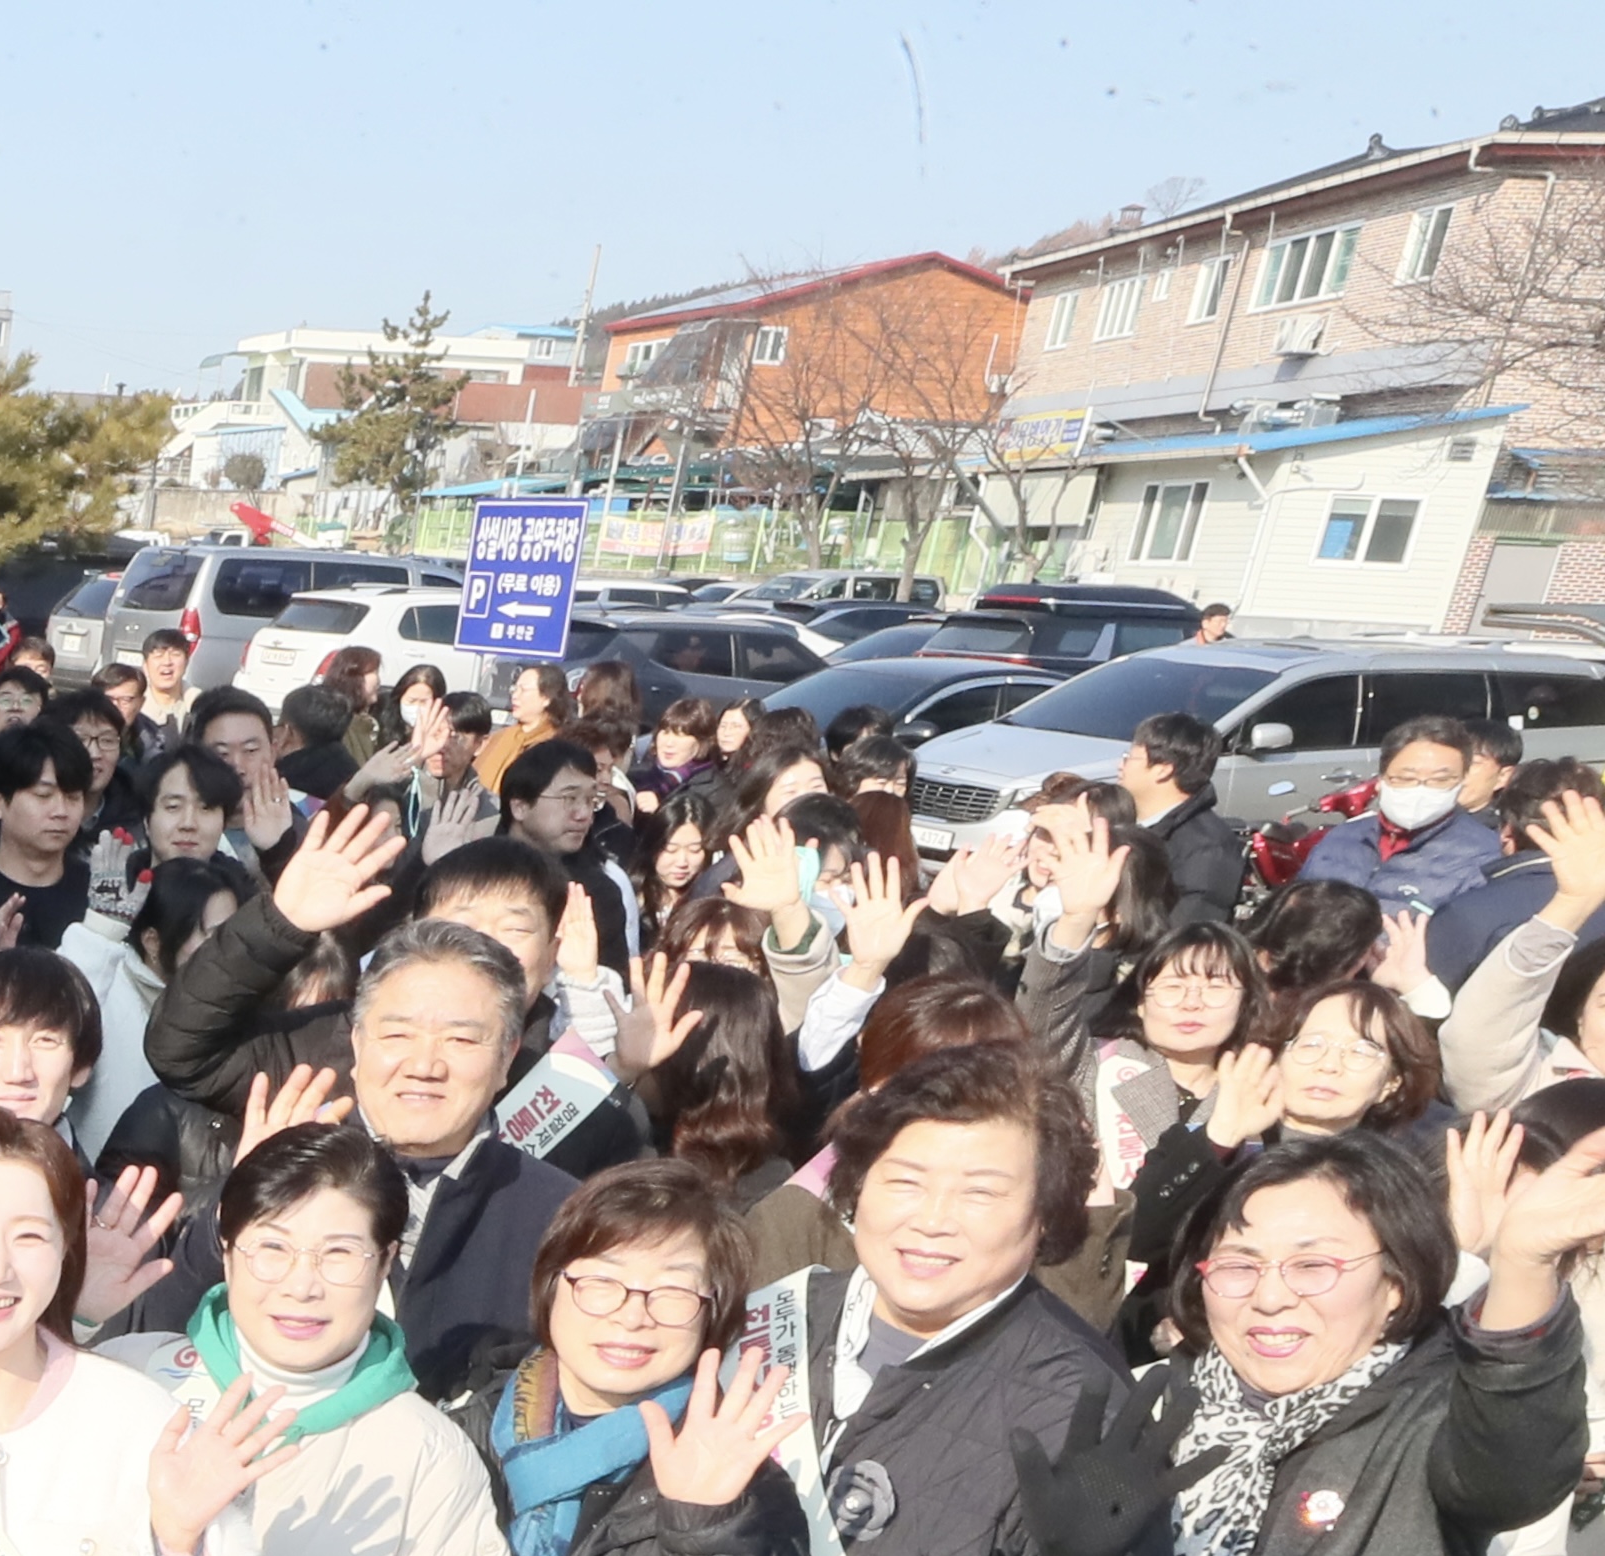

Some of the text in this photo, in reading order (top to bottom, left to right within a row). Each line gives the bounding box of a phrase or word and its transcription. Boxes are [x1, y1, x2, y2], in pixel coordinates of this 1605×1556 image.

[476, 516, 522, 561] 상설시장
[521, 516, 579, 563] 공영주차장
[469, 577, 487, 610] P
[497, 573, 562, 598] (무료 이용)
[774, 1290, 797, 1341] 모두가
